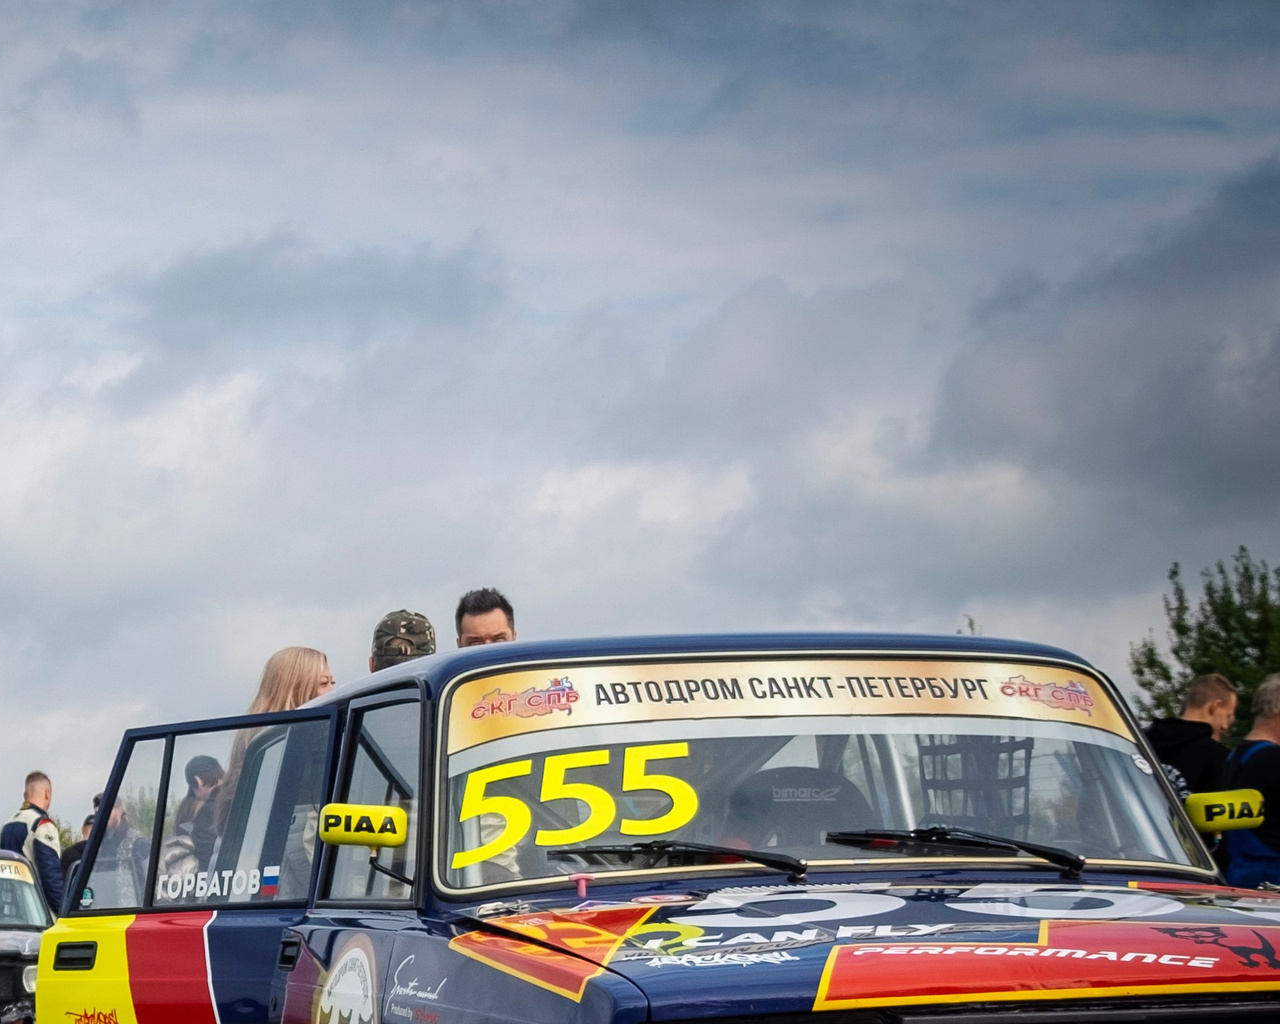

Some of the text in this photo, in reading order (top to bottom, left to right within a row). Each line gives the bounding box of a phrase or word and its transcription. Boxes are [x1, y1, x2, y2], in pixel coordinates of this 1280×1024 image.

[470, 690, 580, 719] СКГ СПБ
[595, 676, 989, 706] АВТОДРОМ САНКТ-ПЕТЕРБУРГ
[999, 683, 1041, 699] СКГ
[451, 741, 699, 869] 555
[323, 814, 398, 835] PIAA
[157, 869, 261, 900] ГОРБАТОВ
[682, 928, 819, 948] CAN
[836, 922, 956, 939] FLY
[852, 945, 1220, 969] PERFORMANCE
